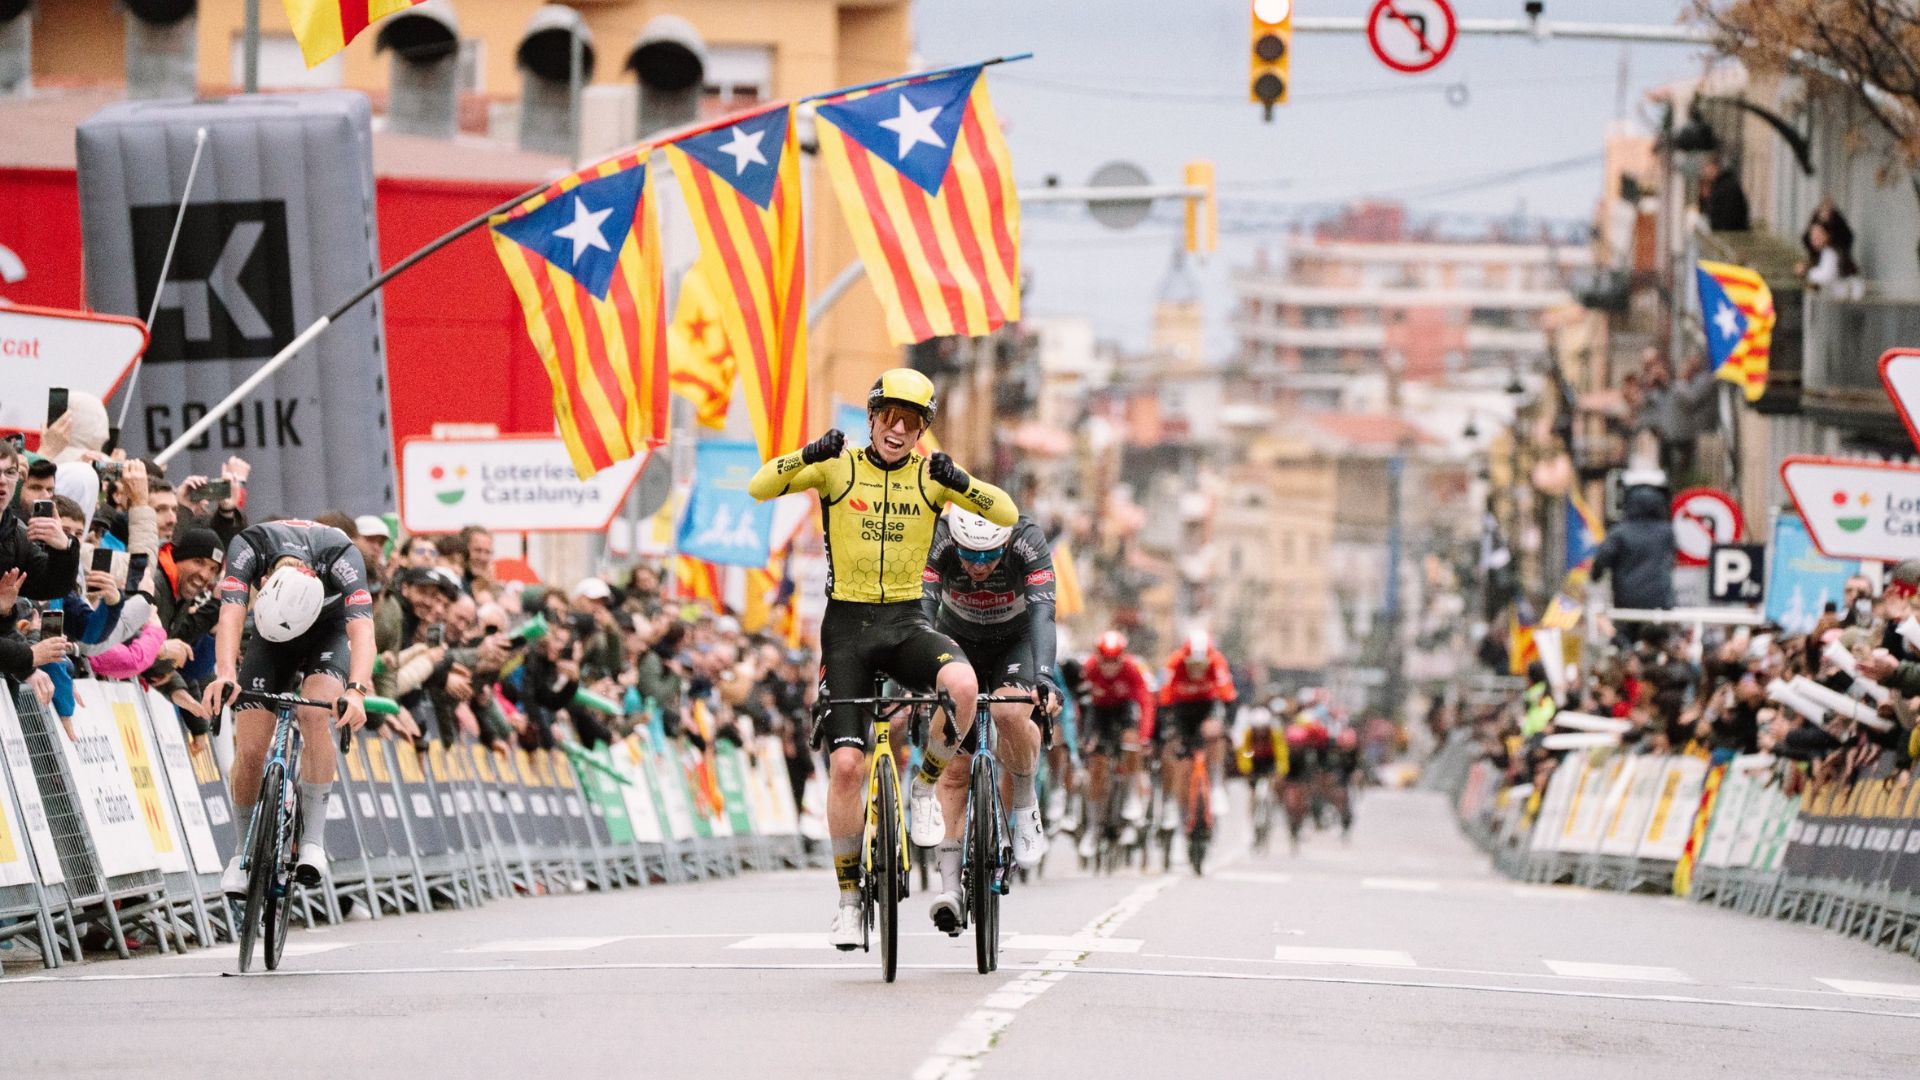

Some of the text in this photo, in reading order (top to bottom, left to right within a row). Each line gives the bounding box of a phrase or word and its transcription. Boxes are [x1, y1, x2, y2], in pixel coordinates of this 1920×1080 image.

[144, 398, 302, 455] GOBIK
[481, 462, 576, 482] Loteries
[480, 483, 600, 507] Catalunya
[873, 501, 921, 516] VISMA
[861, 517, 905, 532] lease
